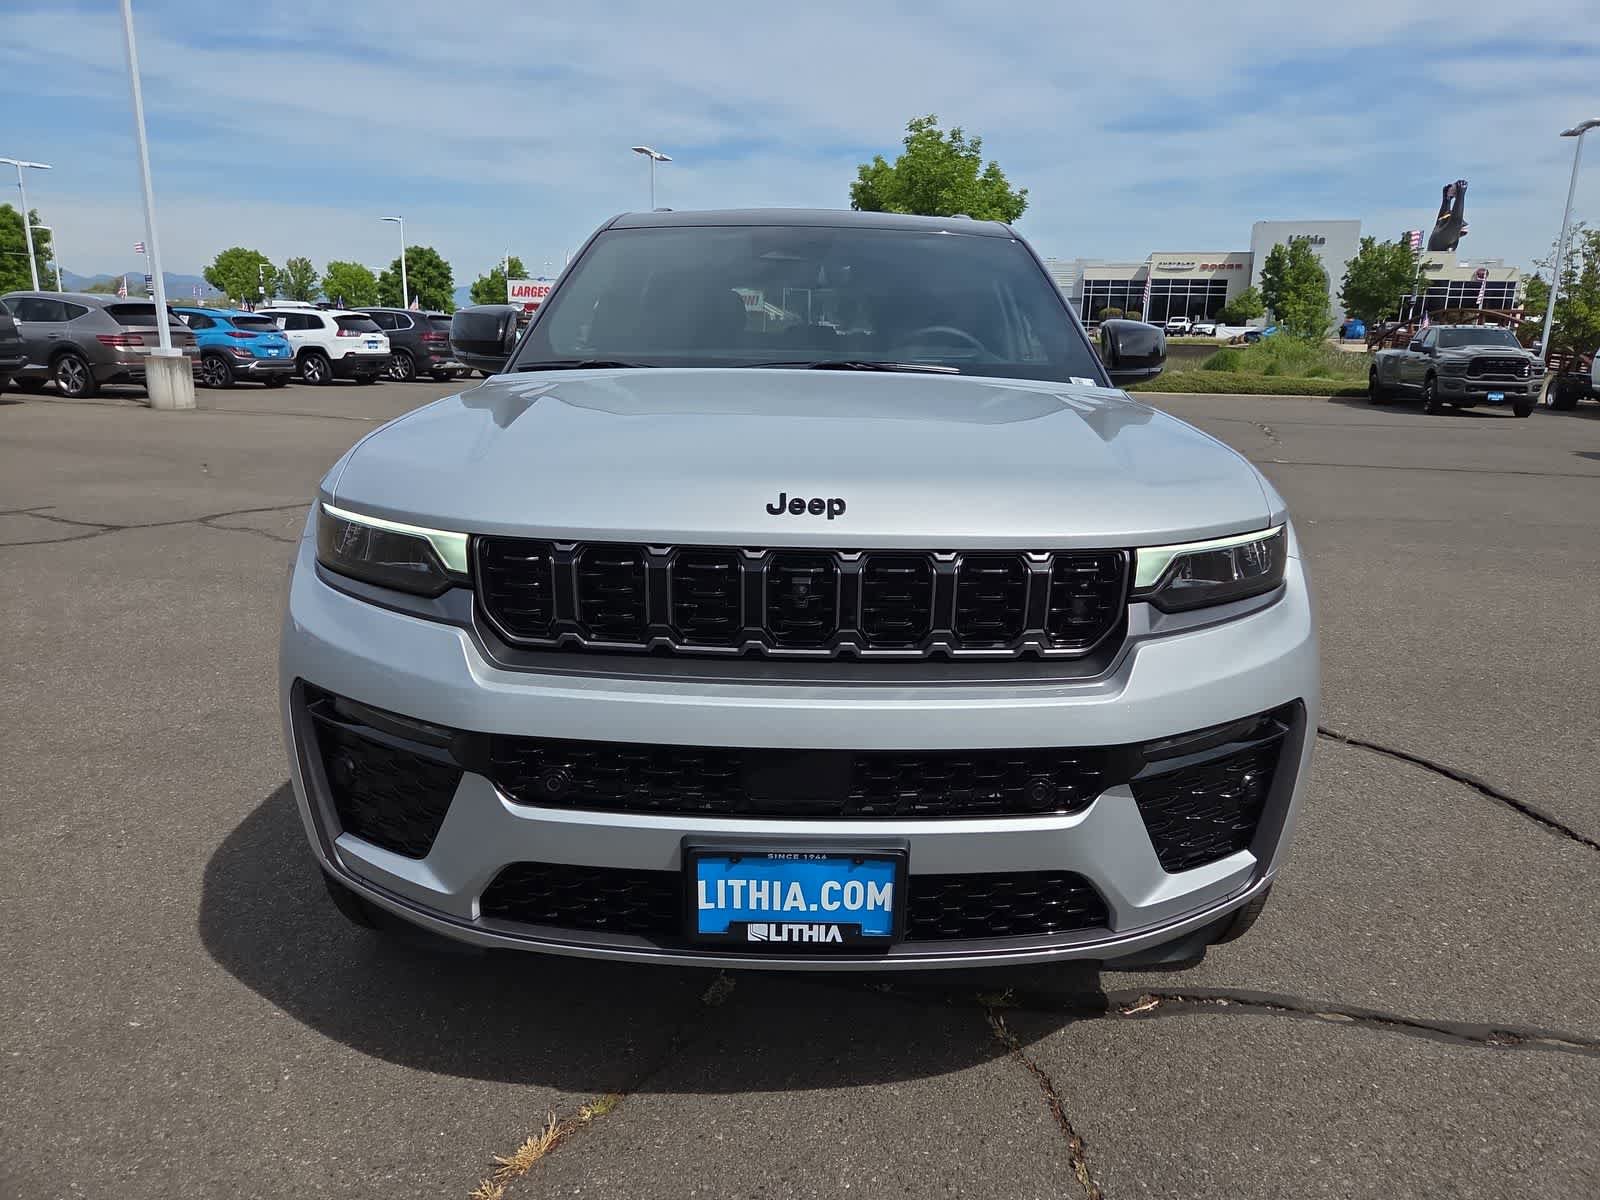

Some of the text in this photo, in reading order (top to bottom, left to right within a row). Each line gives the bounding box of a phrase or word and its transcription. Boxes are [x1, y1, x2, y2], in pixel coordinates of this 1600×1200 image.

[766, 492, 846, 520] Jeep
[697, 880, 894, 912] LITHIA.COM
[768, 924, 843, 943] LITHIA
